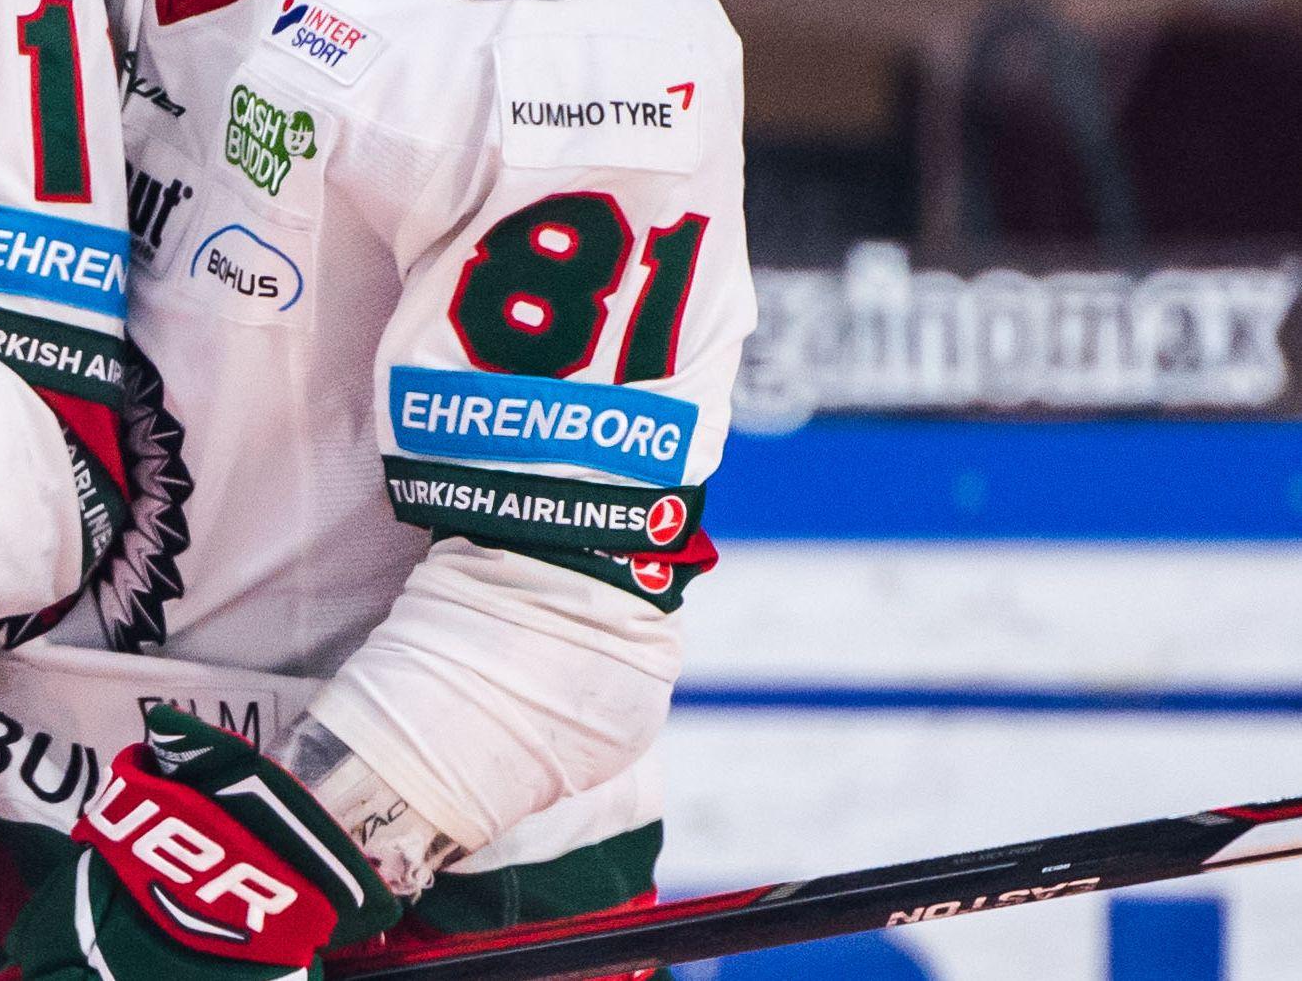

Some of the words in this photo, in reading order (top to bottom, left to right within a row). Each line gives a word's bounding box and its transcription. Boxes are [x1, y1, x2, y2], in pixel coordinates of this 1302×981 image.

[291, 27, 349, 69] SPORT
[304, 4, 361, 50] INTER
[231, 85, 284, 150] CASH
[511, 101, 605, 128] KUMHO
[613, 101, 673, 128] TYRE
[226, 122, 290, 196] BUDDY
[207, 248, 279, 299] BOHUS
[447, 190, 711, 386] 81
[401, 391, 683, 462] EHRENBORG
[389, 478, 494, 515] TURKISH
[497, 493, 649, 532] AIRLINES
